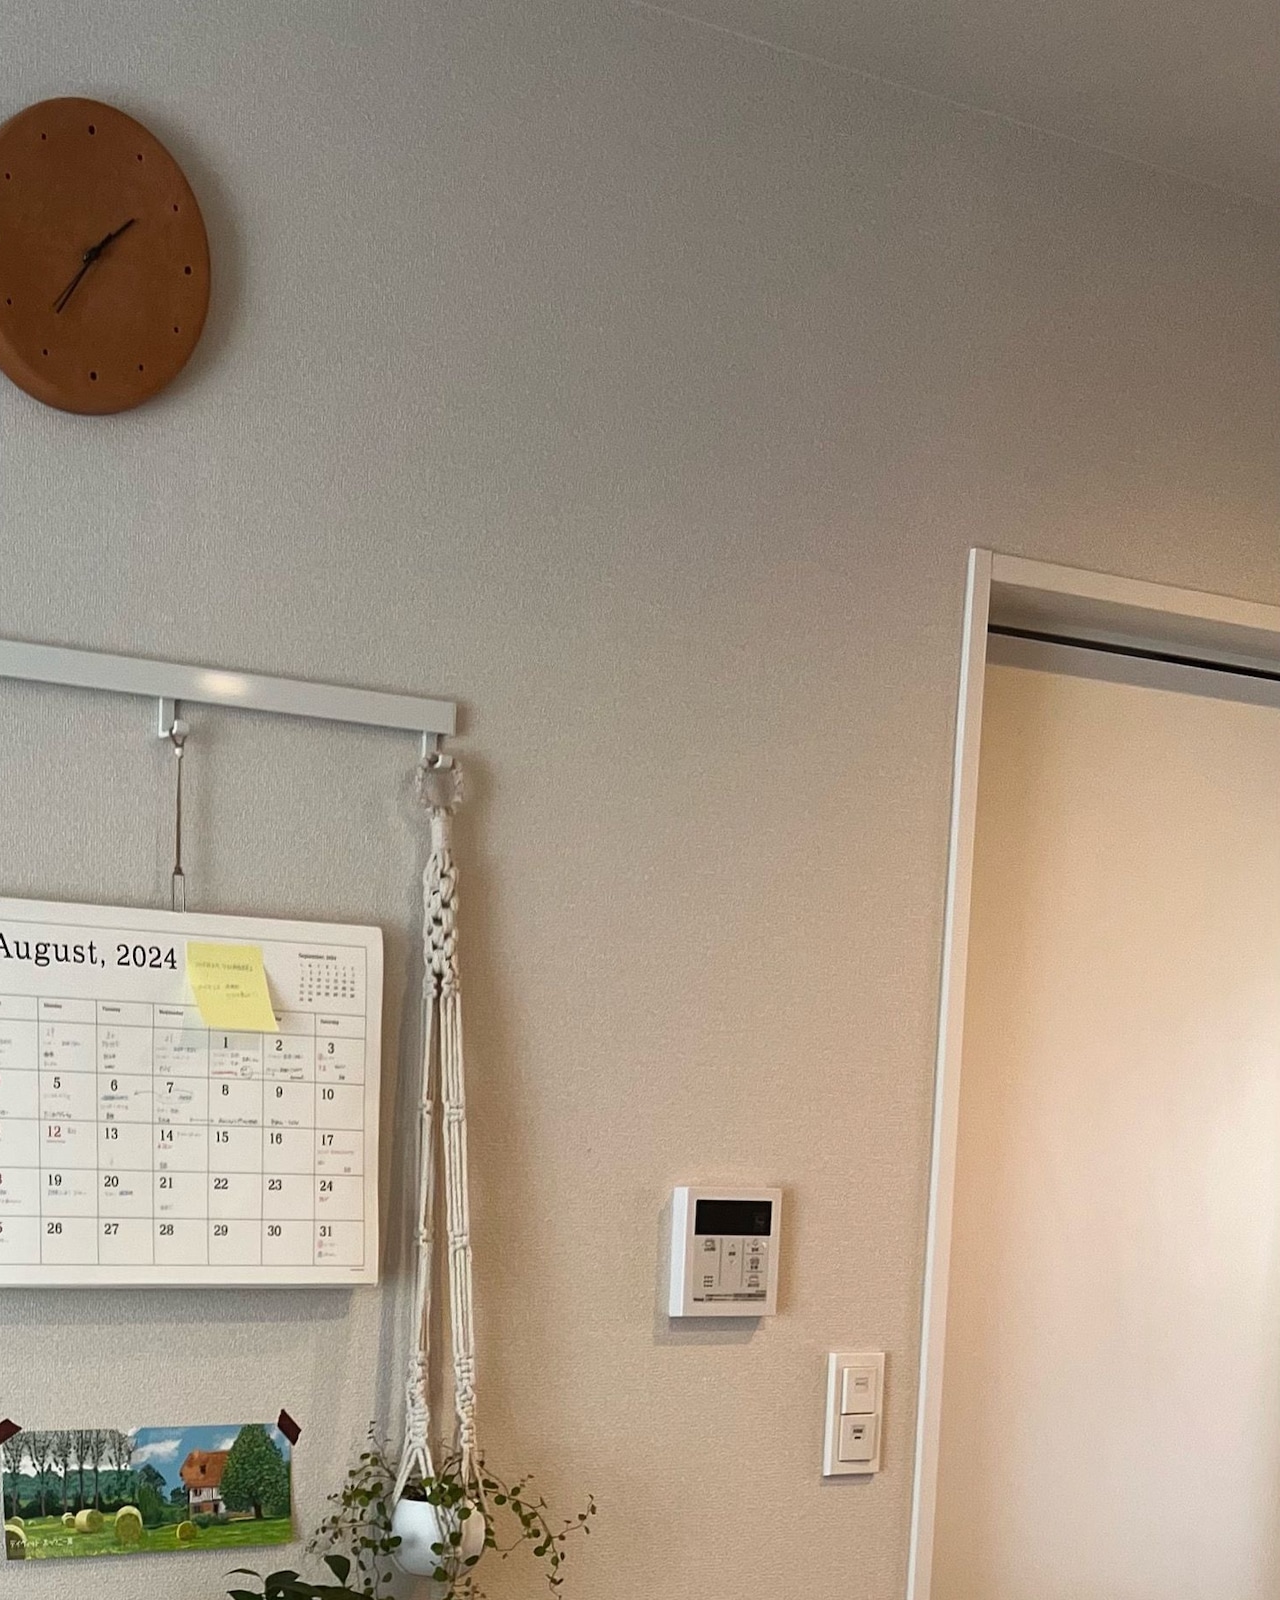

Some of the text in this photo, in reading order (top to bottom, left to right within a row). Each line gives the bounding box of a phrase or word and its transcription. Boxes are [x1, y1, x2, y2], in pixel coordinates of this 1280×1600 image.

[116, 944, 178, 971] 2024
[223, 1035, 335, 1054] 1 2 3
[53, 1076, 61, 1089] 5
[110, 1079, 118, 1092] 6
[166, 1081, 174, 1094] 7
[222, 1084, 229, 1096] 8
[275, 1086, 283, 1098] 9
[322, 1088, 335, 1100] 10
[48, 1125, 62, 1138] 12
[105, 1127, 118, 1140] 13
[161, 1129, 173, 1142] 14
[216, 1131, 229, 1143] 15
[270, 1132, 283, 1145] 16
[322, 1134, 334, 1146] 17
[48, 1174, 62, 1186] 19
[104, 1175, 119, 1188] 20
[159, 1176, 173, 1189] 21
[214, 1178, 229, 1190] 22
[268, 1179, 282, 1191] 23
[319, 1180, 333, 1192] 24
[47, 1222, 63, 1235] 26
[104, 1223, 120, 1235] 27
[159, 1223, 174, 1236] 28
[214, 1224, 229, 1236] 29
[267, 1225, 282, 1237] 30
[319, 1225, 332, 1237] 31
